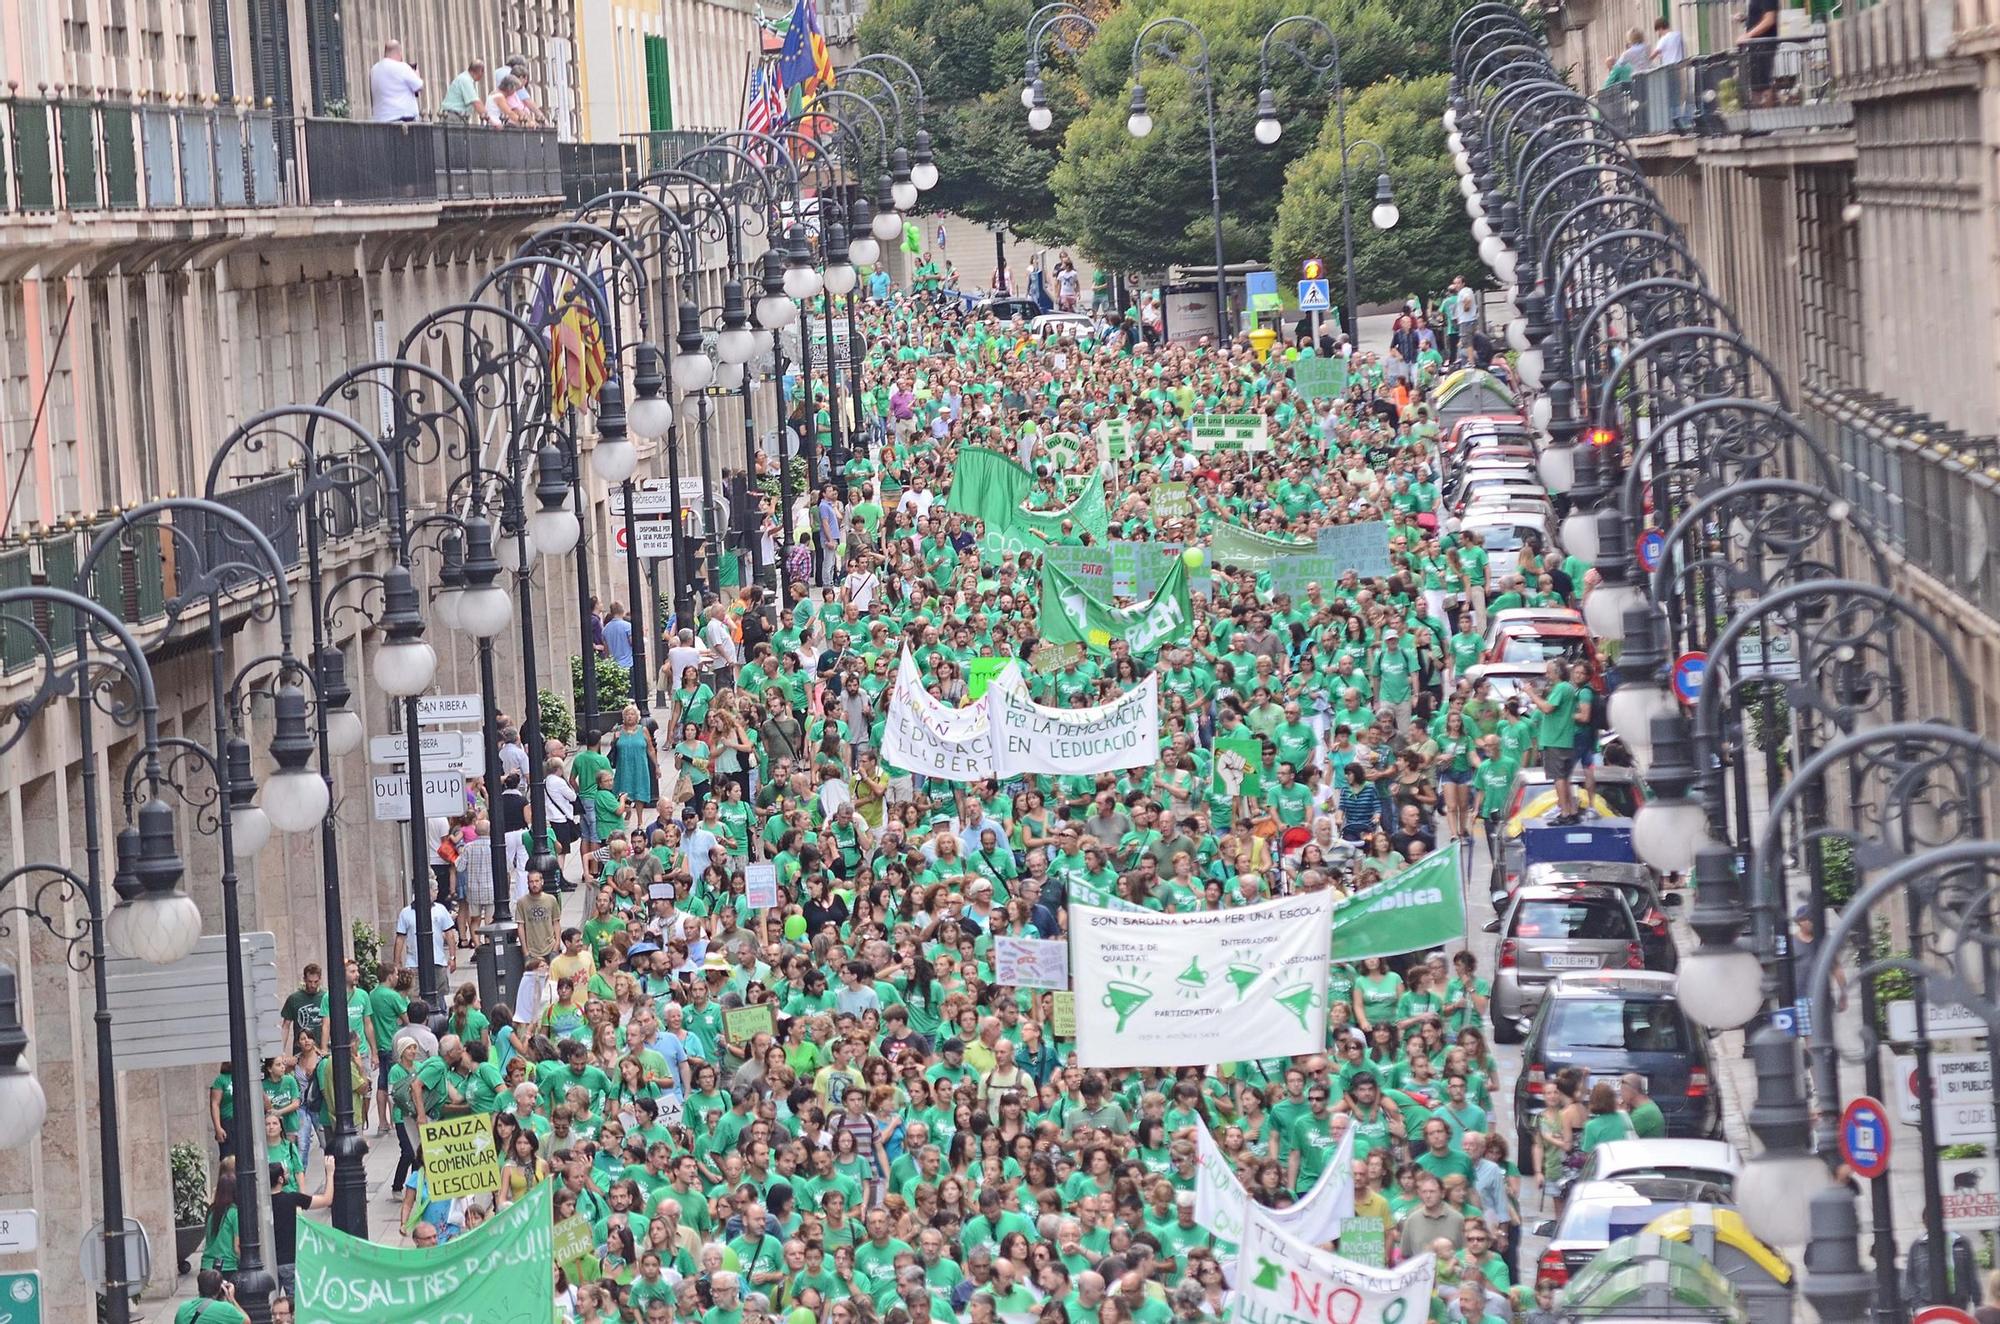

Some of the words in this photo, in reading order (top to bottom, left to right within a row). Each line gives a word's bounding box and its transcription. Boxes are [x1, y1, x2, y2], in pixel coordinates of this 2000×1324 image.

[440, 700, 468, 710] RIBERA
[1032, 718, 1051, 735] LA
[1008, 735, 1031, 754] EN
[374, 778, 460, 798] bultaup
[1090, 916, 1118, 926] SON
[1250, 911, 1274, 922] UNA
[1942, 1060, 1990, 1074] DISPONIBLE
[444, 1141, 476, 1154] VULL
[432, 1170, 498, 1196] L'ESCOLA
[558, 1236, 592, 1262] FUTUR
[296, 1265, 459, 1312] VOSALTRES
[1290, 1271, 1362, 1324] NO
